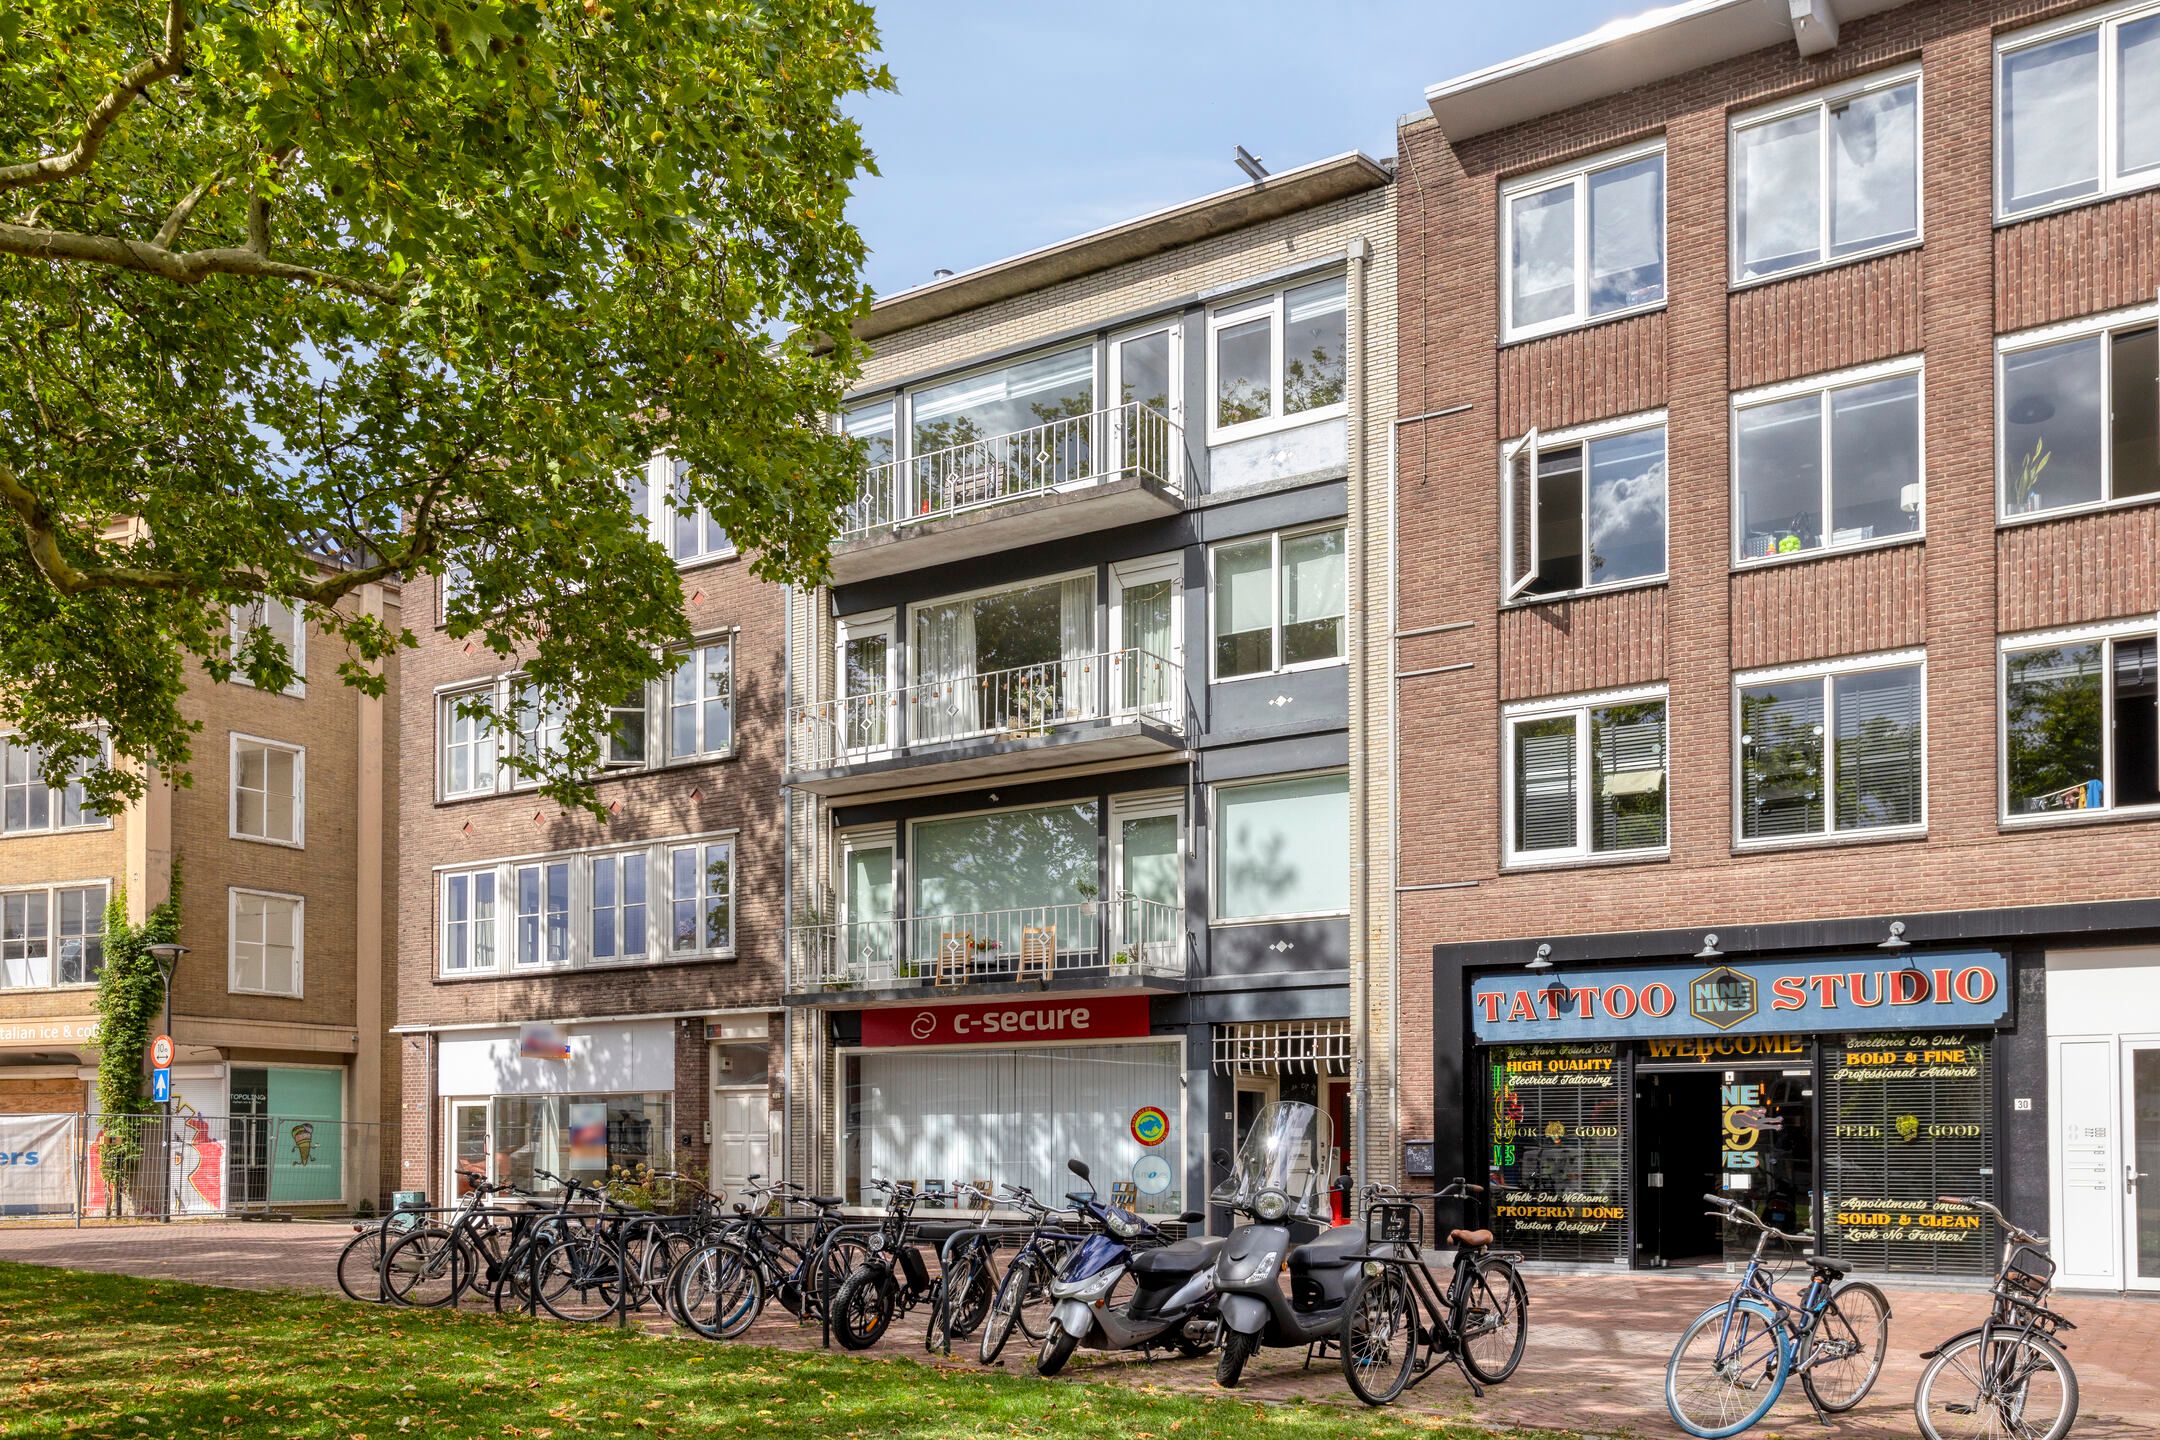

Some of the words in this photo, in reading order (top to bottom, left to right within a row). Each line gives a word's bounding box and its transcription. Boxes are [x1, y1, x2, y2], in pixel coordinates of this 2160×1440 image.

[1477, 982, 1677, 1022] TATTOO
[1771, 966, 1998, 1011] STUDIO
[1696, 982, 1750, 999] NINE
[1696, 997, 1750, 1013] LIVES
[954, 1007, 1090, 1034] c-secure
[40, 1025, 59, 1039] ice
[63, 1024, 73, 1038] &
[1648, 1034, 1804, 1061] WELCOME
[1846, 1036, 1906, 1048] Excellence
[1908, 1035, 1928, 1047] In
[1932, 1034, 1965, 1046] Ink!
[1507, 1045, 1528, 1060] You
[1530, 1045, 1556, 1056] Have
[1559, 1044, 1593, 1055] Found
[1594, 1043, 1612, 1054] It!
[1846, 1052, 1897, 1065] BOLD
[1904, 1051, 1918, 1064] &
[1924, 1049, 1966, 1063] FINE
[1506, 1060, 1543, 1073] HIGH
[1548, 1058, 1613, 1072] QUALITY
[1833, 1067, 1917, 1081] Professional
[1919, 1065, 1977, 1078] Artwork
[1508, 1075, 1558, 1086] Electrical
[1560, 1074, 1613, 1087] Tattooing
[2017, 1099, 2029, 1109] 30
[1575, 1126, 1617, 1137] GOOD
[1835, 1125, 1880, 1137] FEEL
[1928, 1125, 1980, 1137] GOOD
[1505, 1192, 1557, 1203] Walk-Ins
[1558, 1192, 1609, 1203] Welcome
[1840, 1197, 1926, 1211] Appointments
[1496, 1206, 1575, 1218] PROPERLY
[1582, 1207, 1624, 1219] DONE
[1515, 1219, 1553, 1231] Custom
[1554, 1221, 1607, 1234] Designs!
[1838, 1213, 1892, 1226] SOLID
[1899, 1213, 1912, 1226] &
[1918, 1213, 1980, 1228] CLEAN
[1843, 1227, 1879, 1242] Look
[1882, 1227, 1905, 1241] No
[1907, 1229, 1968, 1242] Further!
